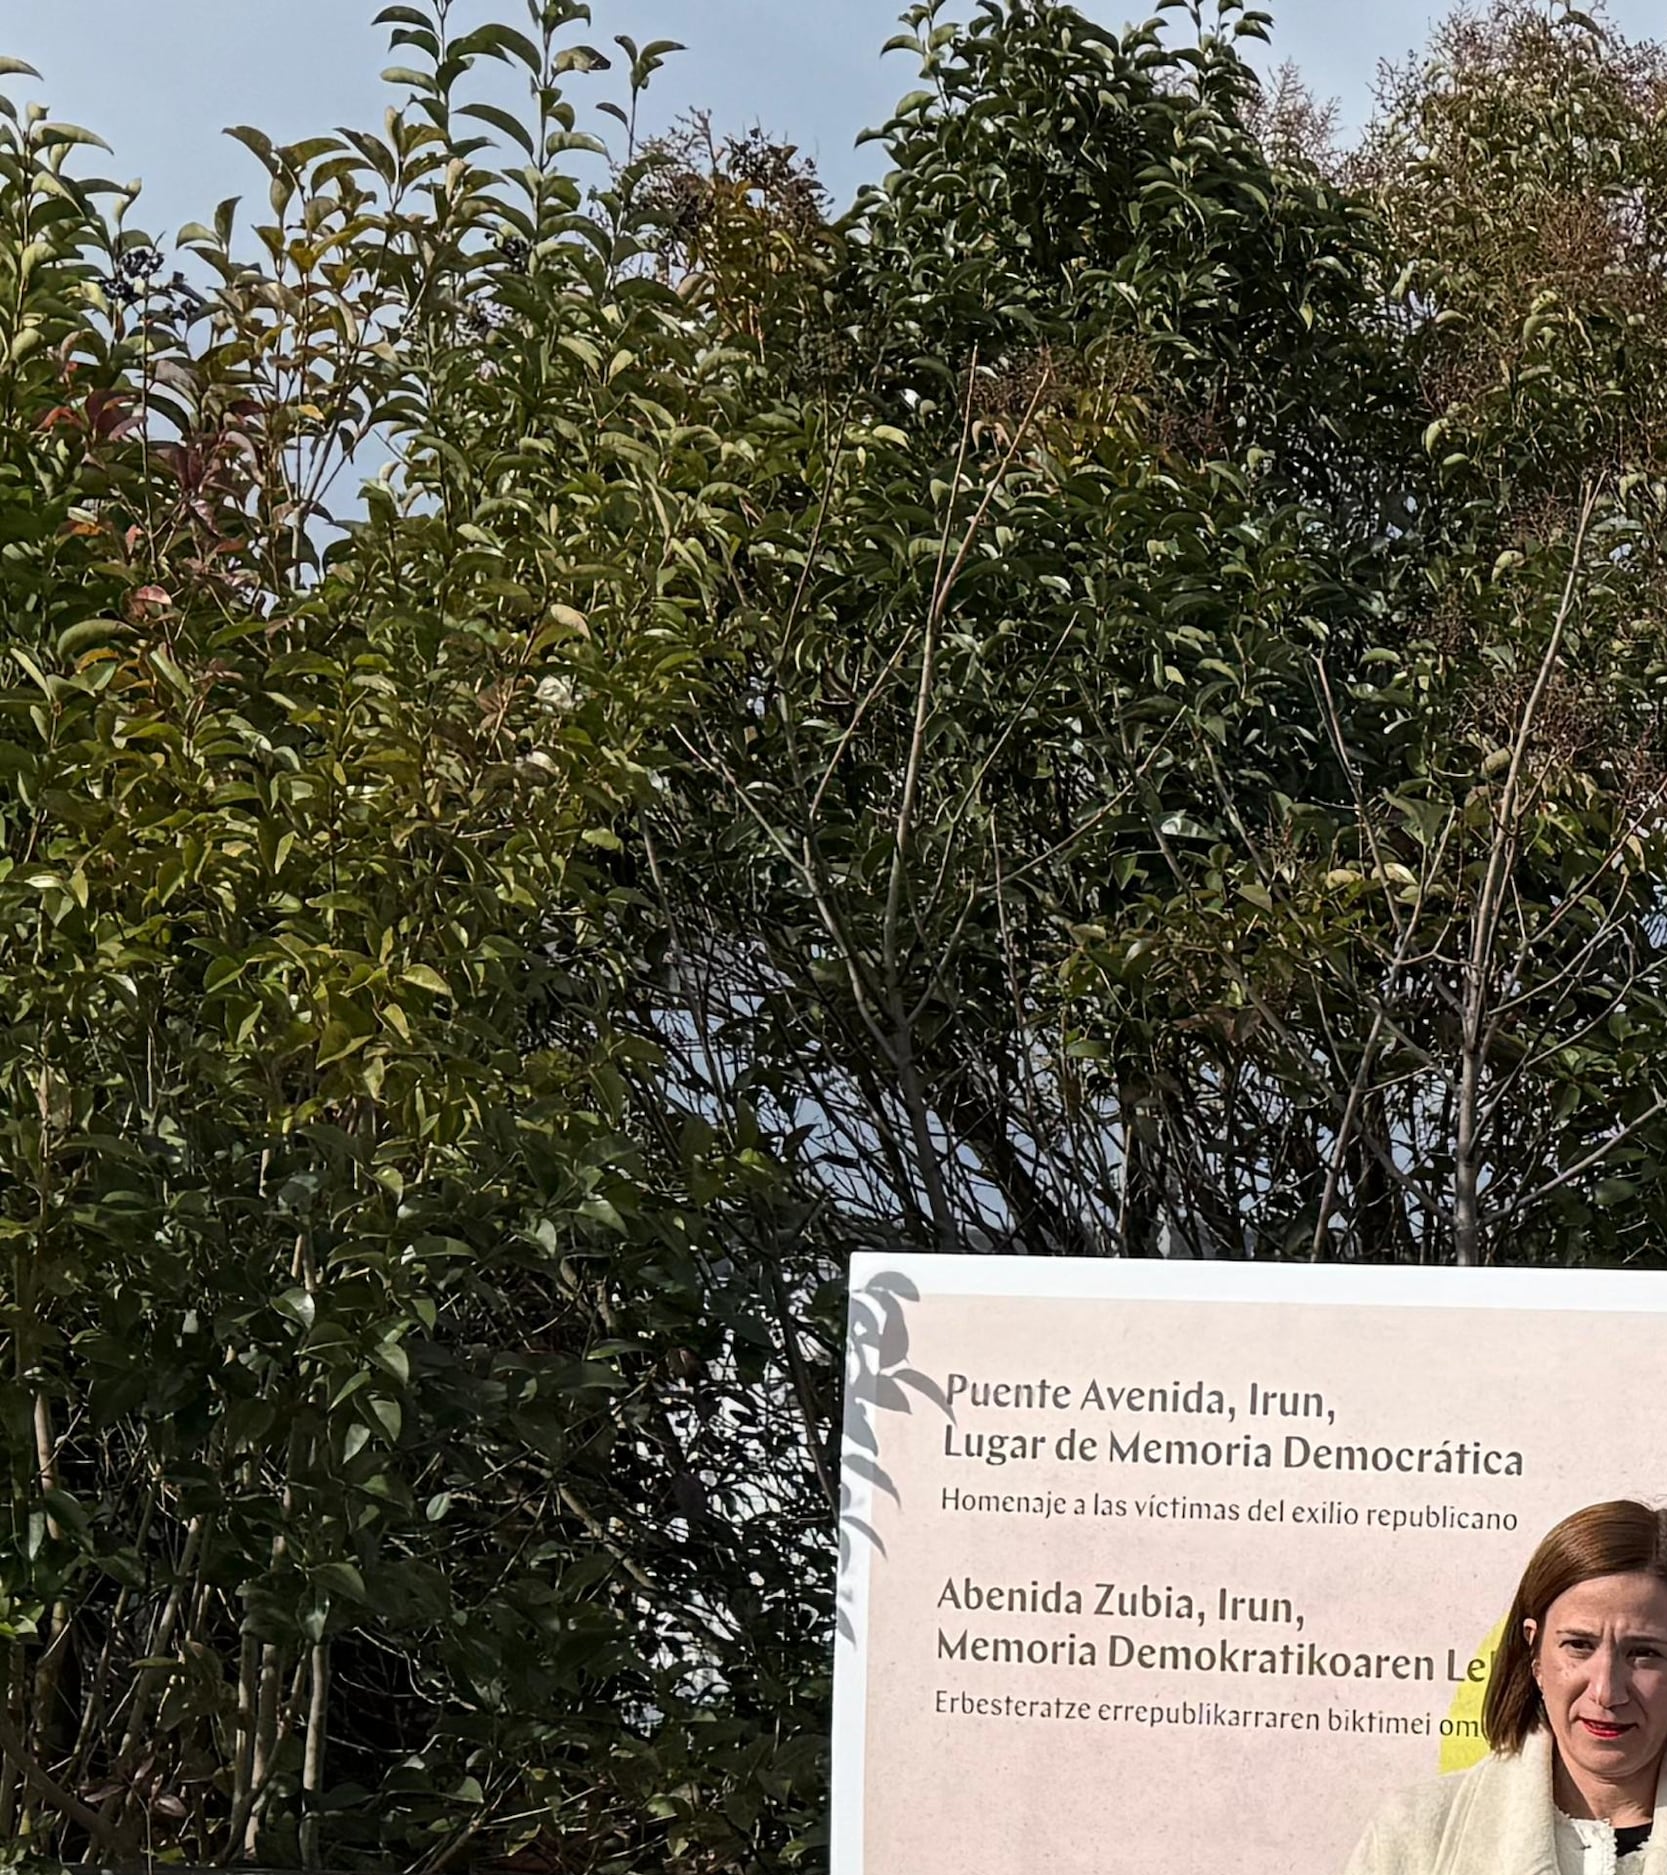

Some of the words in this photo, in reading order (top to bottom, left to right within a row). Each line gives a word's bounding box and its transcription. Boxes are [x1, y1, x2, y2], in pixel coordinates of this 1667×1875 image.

[946, 1373, 1071, 1409] Puente
[1080, 1379, 1236, 1422] Avenida,
[1250, 1383, 1336, 1424] Irun,
[944, 1425, 1045, 1465] Lugar
[1055, 1429, 1097, 1461] de
[1109, 1430, 1272, 1468] Memoria
[1284, 1435, 1524, 1476] Democrática
[941, 1487, 1066, 1518] Homenaje
[1073, 1499, 1085, 1515] a
[1094, 1493, 1127, 1517] las
[1135, 1495, 1239, 1521] víctimas
[1247, 1498, 1285, 1523] del
[1292, 1501, 1359, 1525] exilio
[1366, 1504, 1518, 1531] republicano
[937, 1577, 1083, 1615] Abenida
[1093, 1582, 1206, 1627] Zubia,
[1218, 1588, 1304, 1629] Irun,
[937, 1628, 1096, 1666] Memoria
[1108, 1633, 1434, 1682] Demokratikoaren
[1448, 1646, 1496, 1682] Le
[936, 1690, 1091, 1719] Erbesteratze
[1098, 1701, 1320, 1731] errepublikarraren
[1328, 1708, 1431, 1735] biktimei
